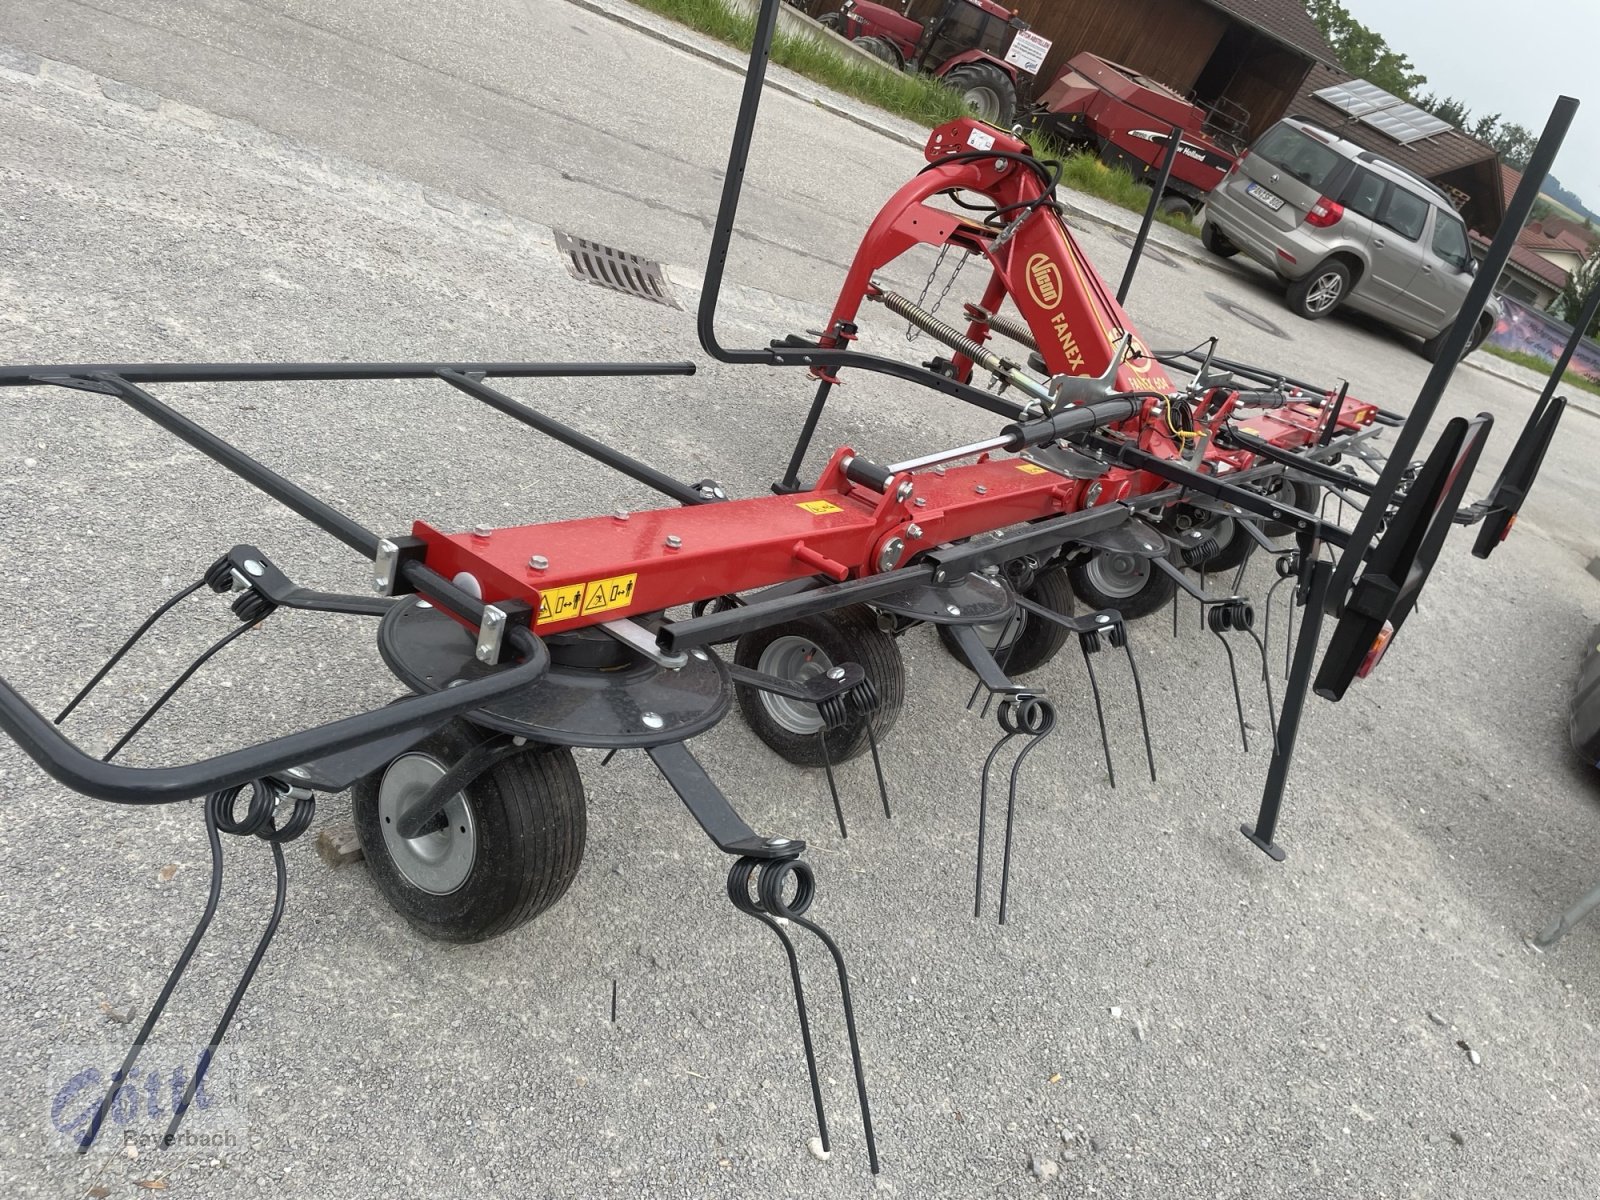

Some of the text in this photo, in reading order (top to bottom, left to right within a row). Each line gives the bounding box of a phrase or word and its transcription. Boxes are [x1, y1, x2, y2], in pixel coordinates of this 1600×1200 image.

[1183, 147, 1206, 162] Holland
[1029, 255, 1060, 304] Vicon
[1051, 312, 1085, 372] FANEX
[1127, 377, 1154, 391] FANEX
